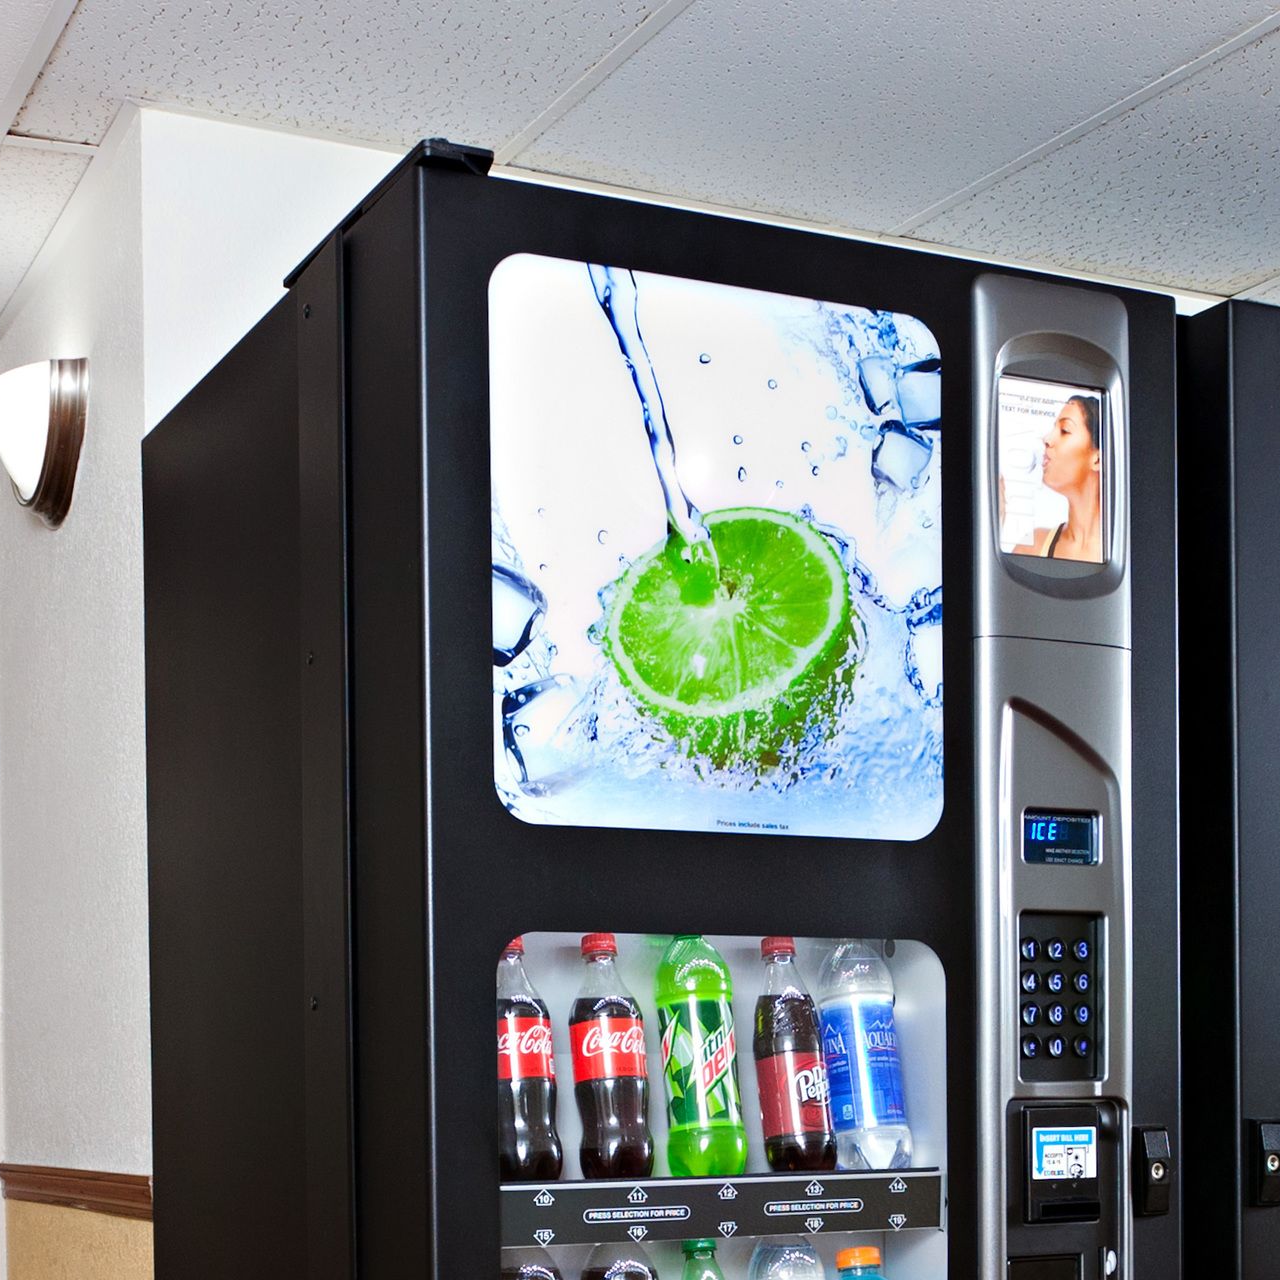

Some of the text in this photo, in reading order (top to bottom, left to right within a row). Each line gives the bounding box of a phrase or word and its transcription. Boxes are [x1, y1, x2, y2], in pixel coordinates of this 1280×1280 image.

[716, 819, 736, 827] Prices
[1031, 822, 1057, 840] ICE
[1028, 942, 1088, 957] 1 2 3
[1026, 974, 1088, 990] 4 5 6
[1028, 1006, 1088, 1022] 7 8 9
[1054, 1039, 1062, 1055] 0
[794, 1070, 830, 1102] Pepp
[809, 1185, 819, 1194] 13
[893, 1182, 902, 1191] 14
[633, 1192, 642, 1200] 11
[723, 1189, 733, 1197] 12
[539, 1195, 550, 1204] 10
[790, 1203, 825, 1211] SELECTION
[612, 1210, 649, 1219] SELECTION
[665, 1209, 685, 1217] PRICE
[809, 1220, 819, 1228] 18
[893, 1217, 902, 1225] 19
[633, 1228, 643, 1236] 16
[723, 1224, 732, 1232] 17
[539, 1232, 549, 1240] 15
